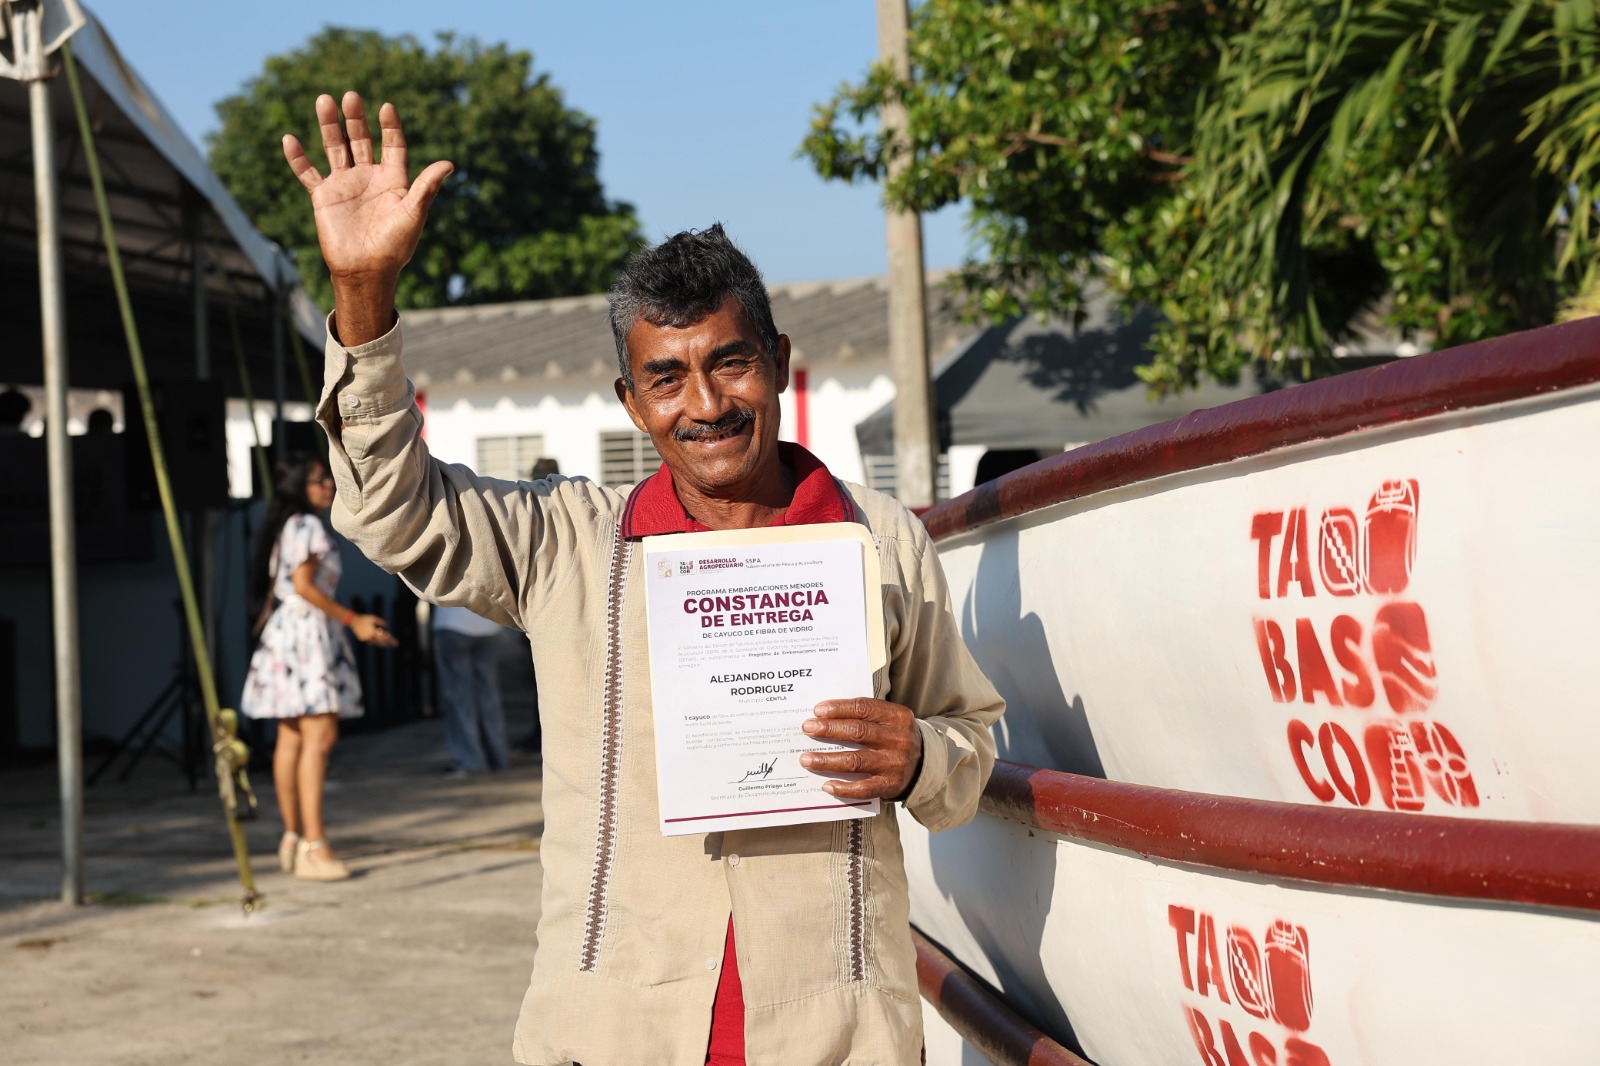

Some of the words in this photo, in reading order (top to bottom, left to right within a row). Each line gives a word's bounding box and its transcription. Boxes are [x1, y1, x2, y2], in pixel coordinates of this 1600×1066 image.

[728, 585, 788, 594] EMBARCACIONES
[684, 590, 829, 614] CONSTANCIA
[701, 614, 724, 628] DE
[730, 609, 814, 626] ENTREGA
[1252, 613, 1375, 709] BAS
[710, 671, 775, 683] ALEJANDRO
[778, 669, 812, 679] LOPEZ
[730, 684, 794, 696] RODRIGUEZ
